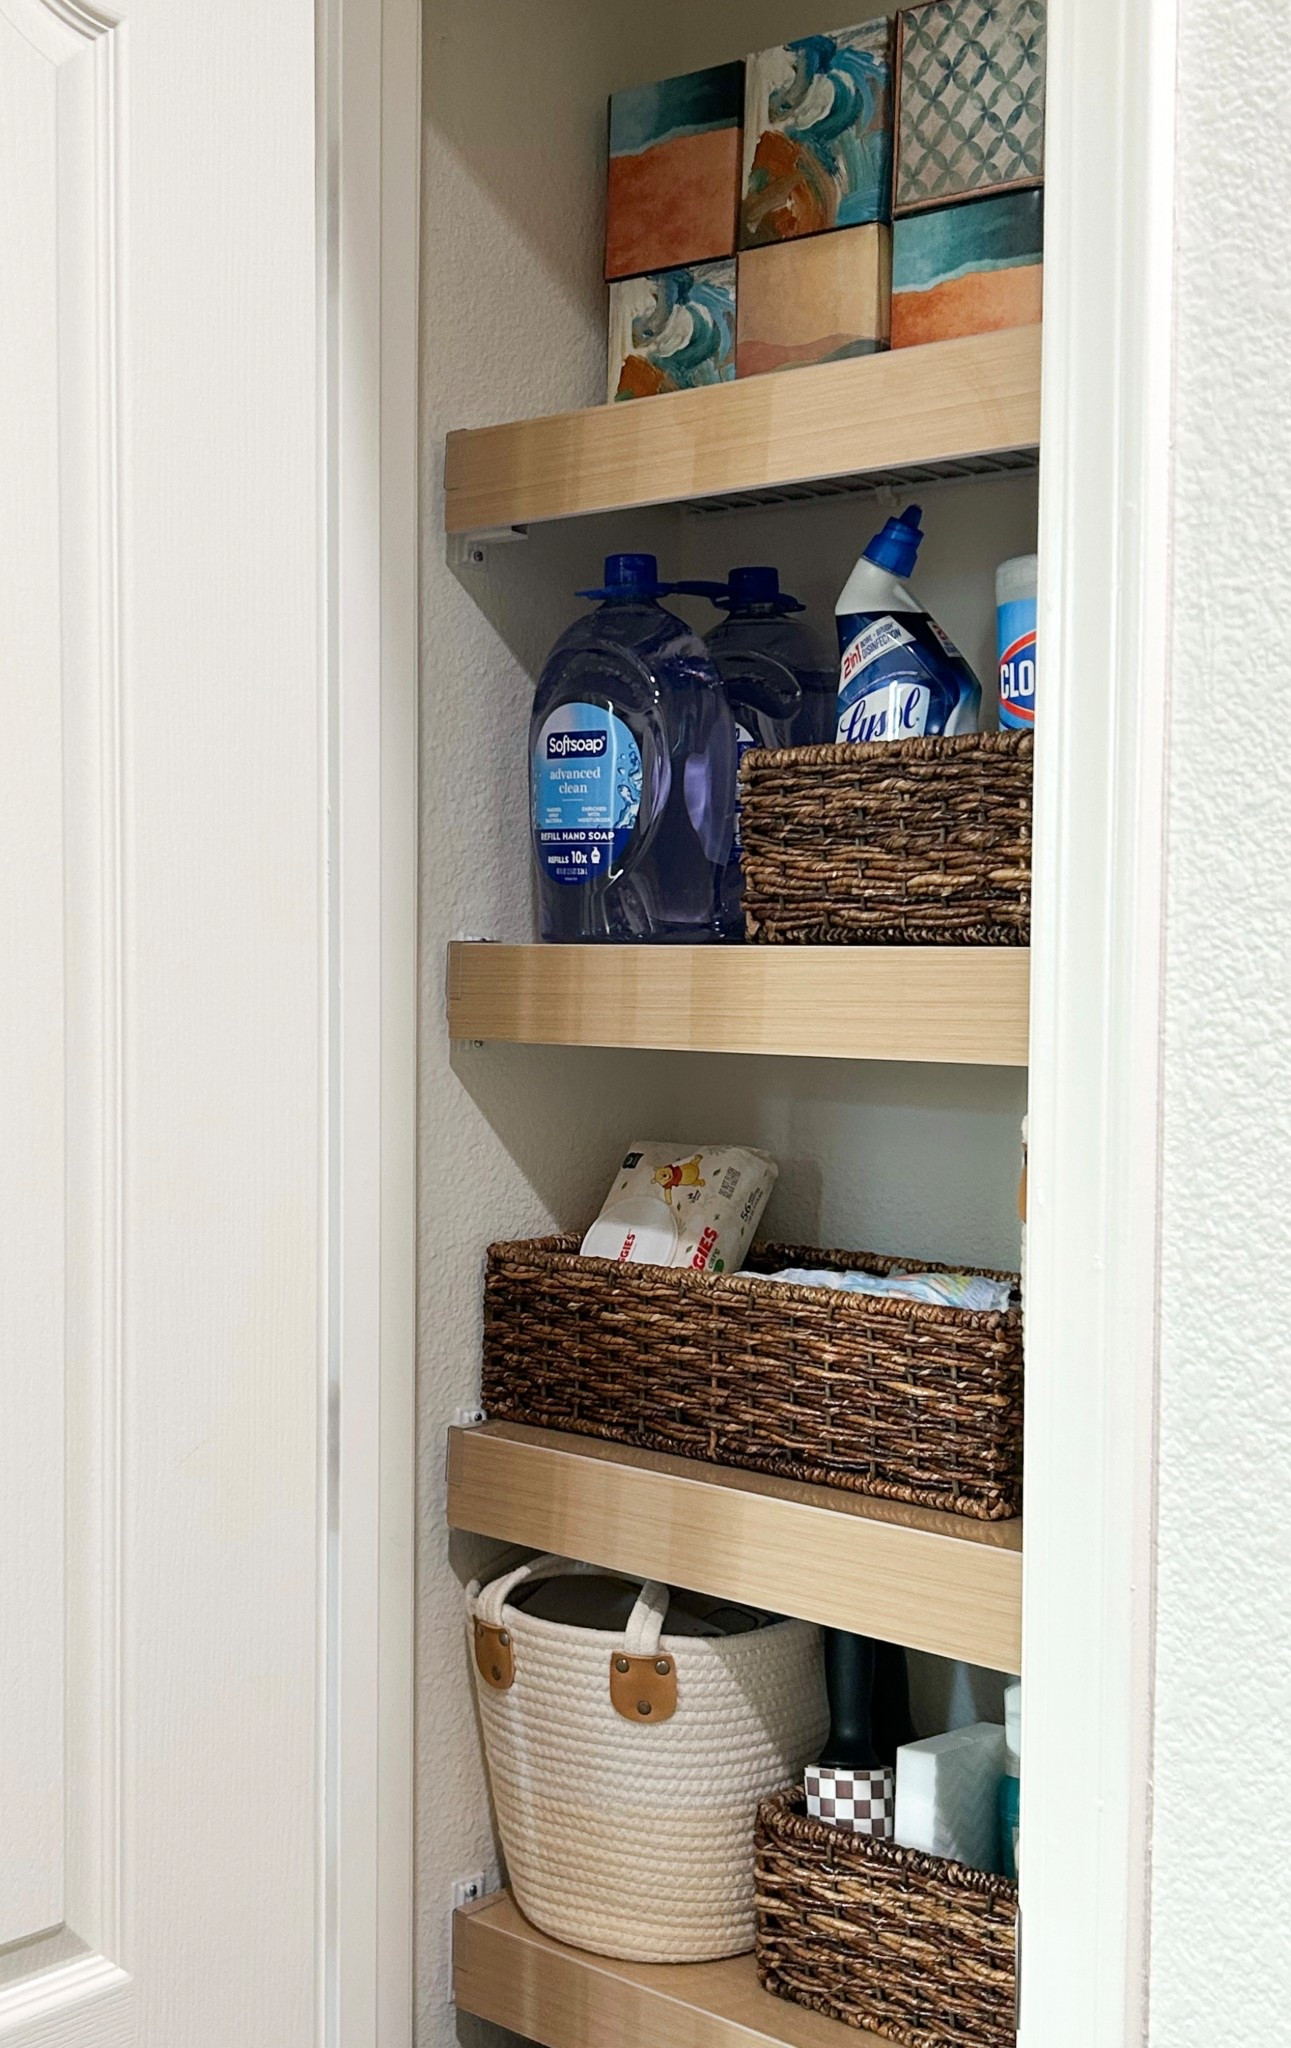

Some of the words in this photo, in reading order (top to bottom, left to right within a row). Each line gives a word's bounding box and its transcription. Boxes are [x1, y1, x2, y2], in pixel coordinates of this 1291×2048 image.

[862, 628, 902, 660] DISINFECTON
[549, 734, 604, 756] Softsoap
[549, 766, 601, 780] advanced
[558, 782, 588, 794] clean
[541, 832, 561, 841] REFILL
[562, 832, 586, 841] HAND
[588, 831, 615, 841] SOAP
[547, 855, 569, 864] REFILLS
[571, 850, 588, 864] 10x
[740, 1202, 752, 1222] 56
[690, 1226, 719, 1272] GIES
